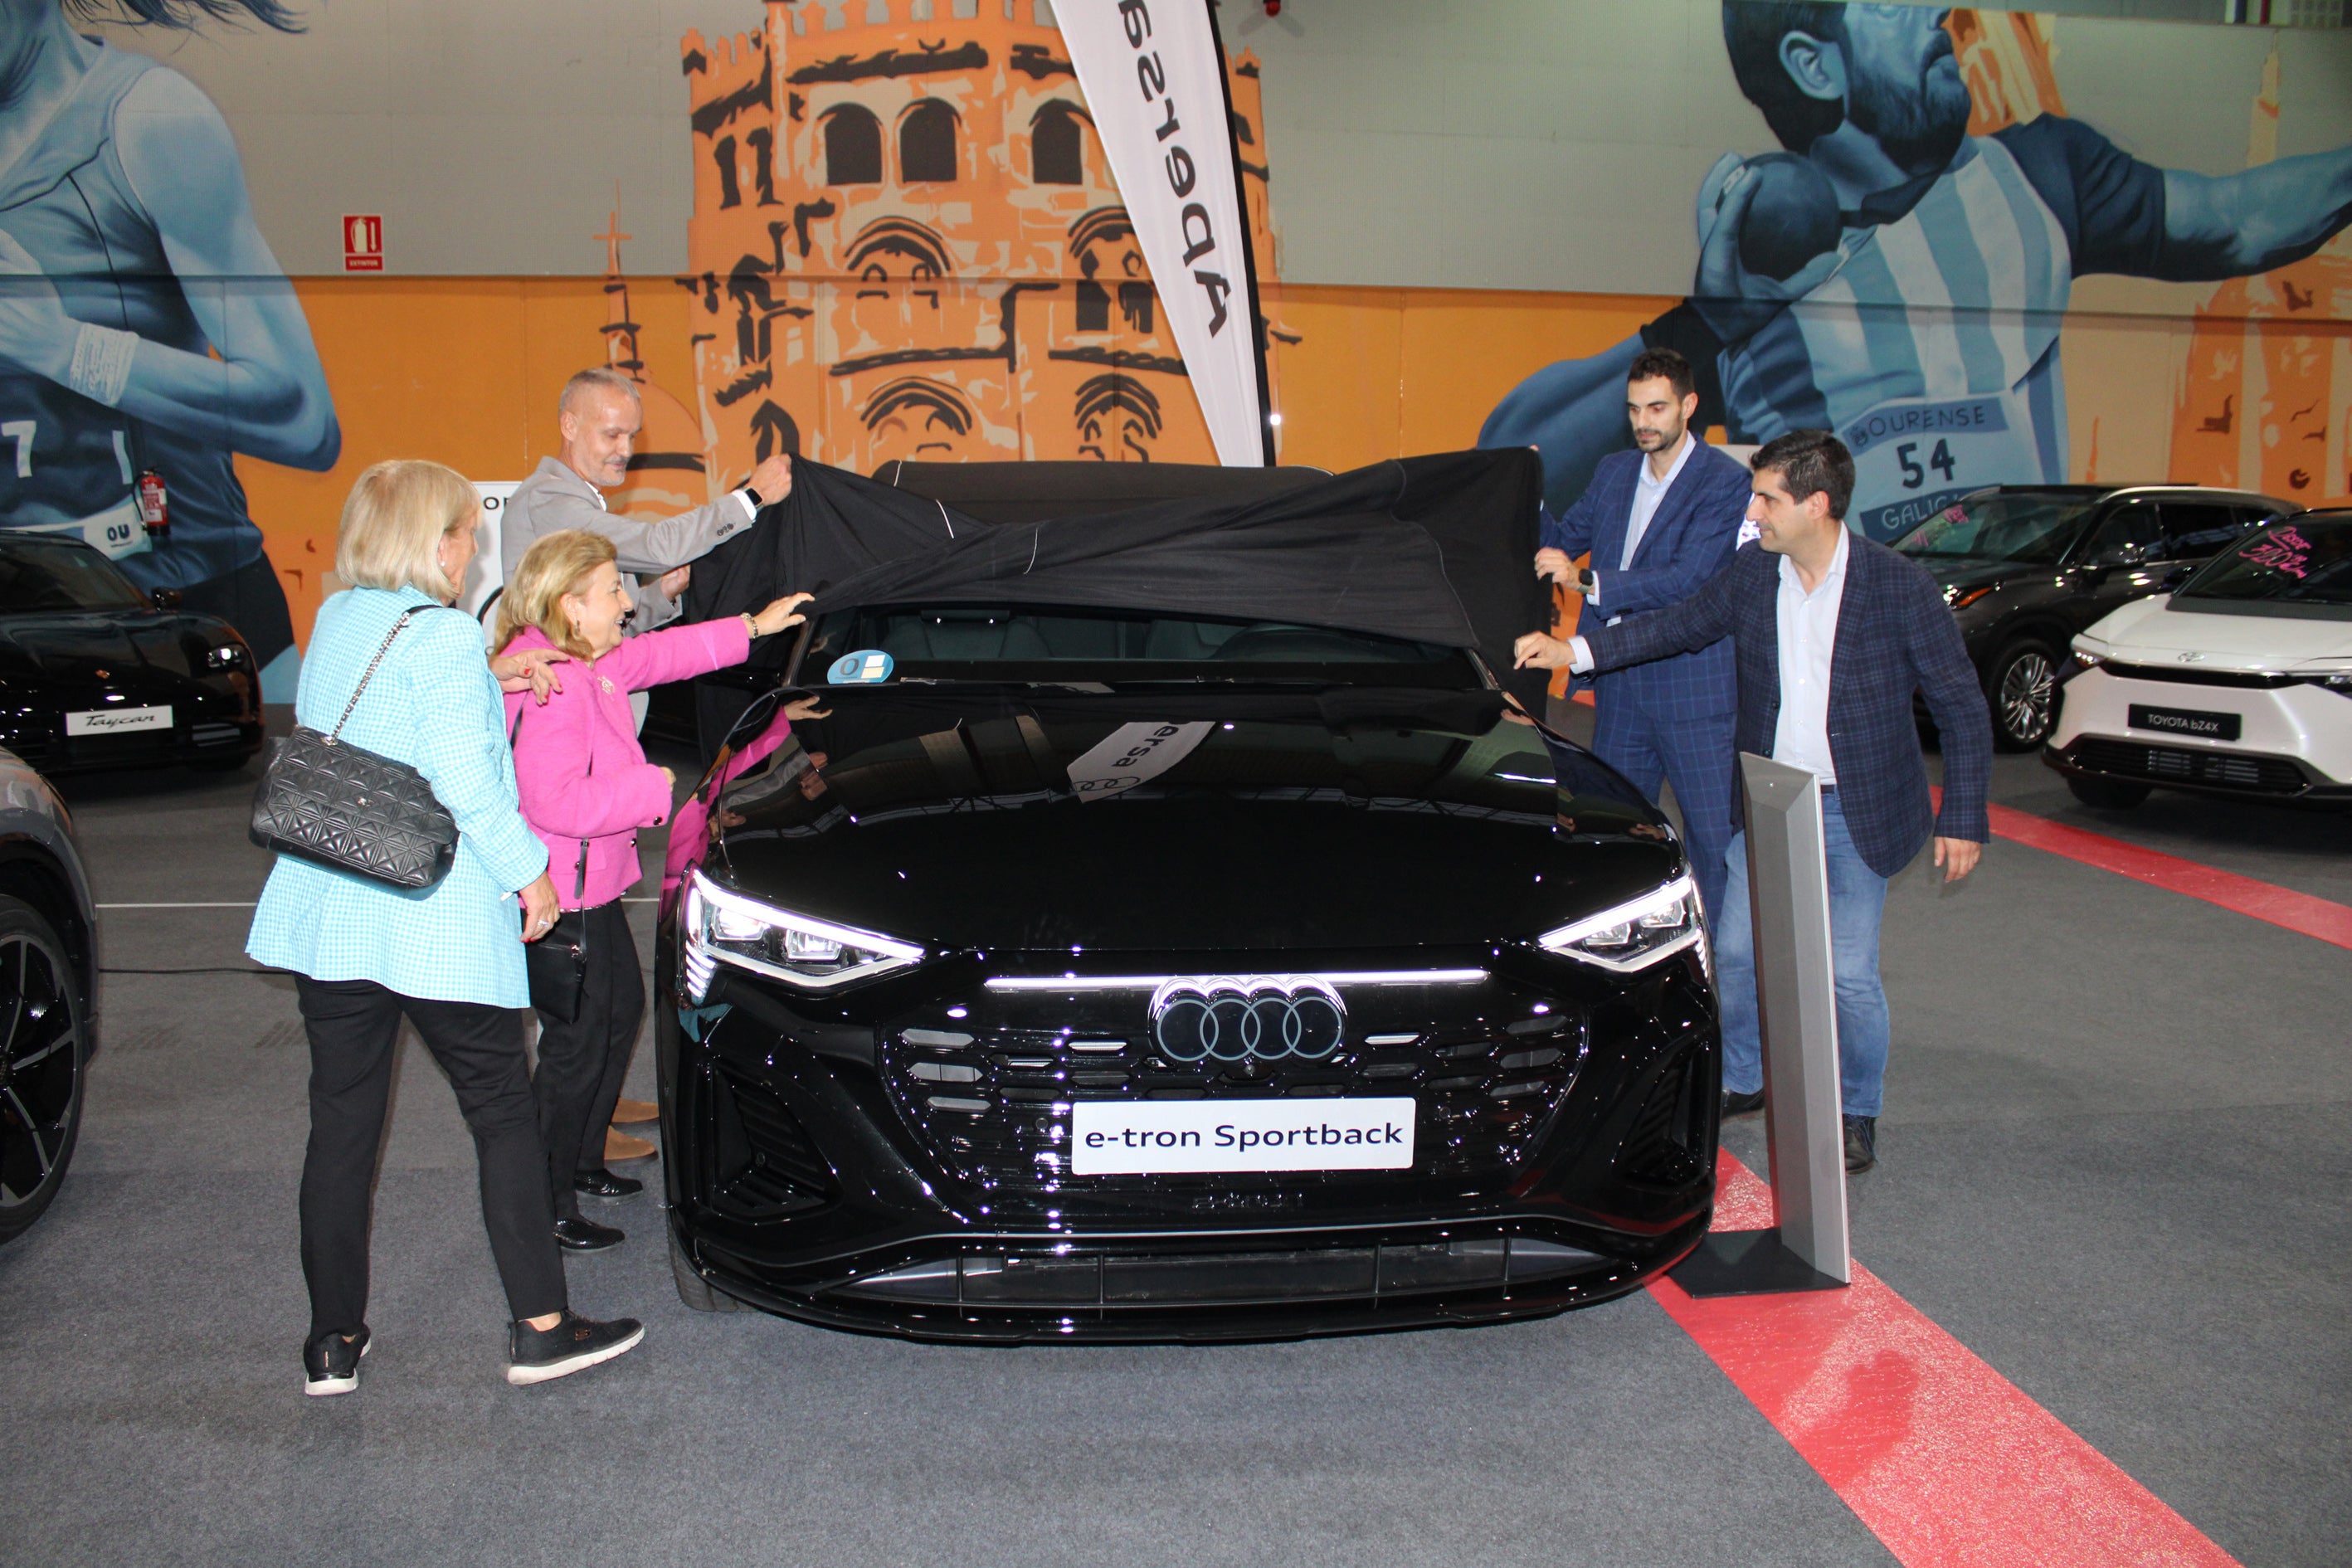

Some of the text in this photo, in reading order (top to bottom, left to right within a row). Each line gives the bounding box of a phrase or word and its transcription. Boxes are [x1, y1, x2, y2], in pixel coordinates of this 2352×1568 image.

[1868, 405, 1985, 437] OURENSE
[1897, 438, 1955, 489] 54
[106, 524, 130, 541] OU
[85, 714, 155, 728] Taycan
[2147, 713, 2220, 733] TOYOTA bZ4X
[1084, 1122, 1405, 1153] e-tron Sportback
